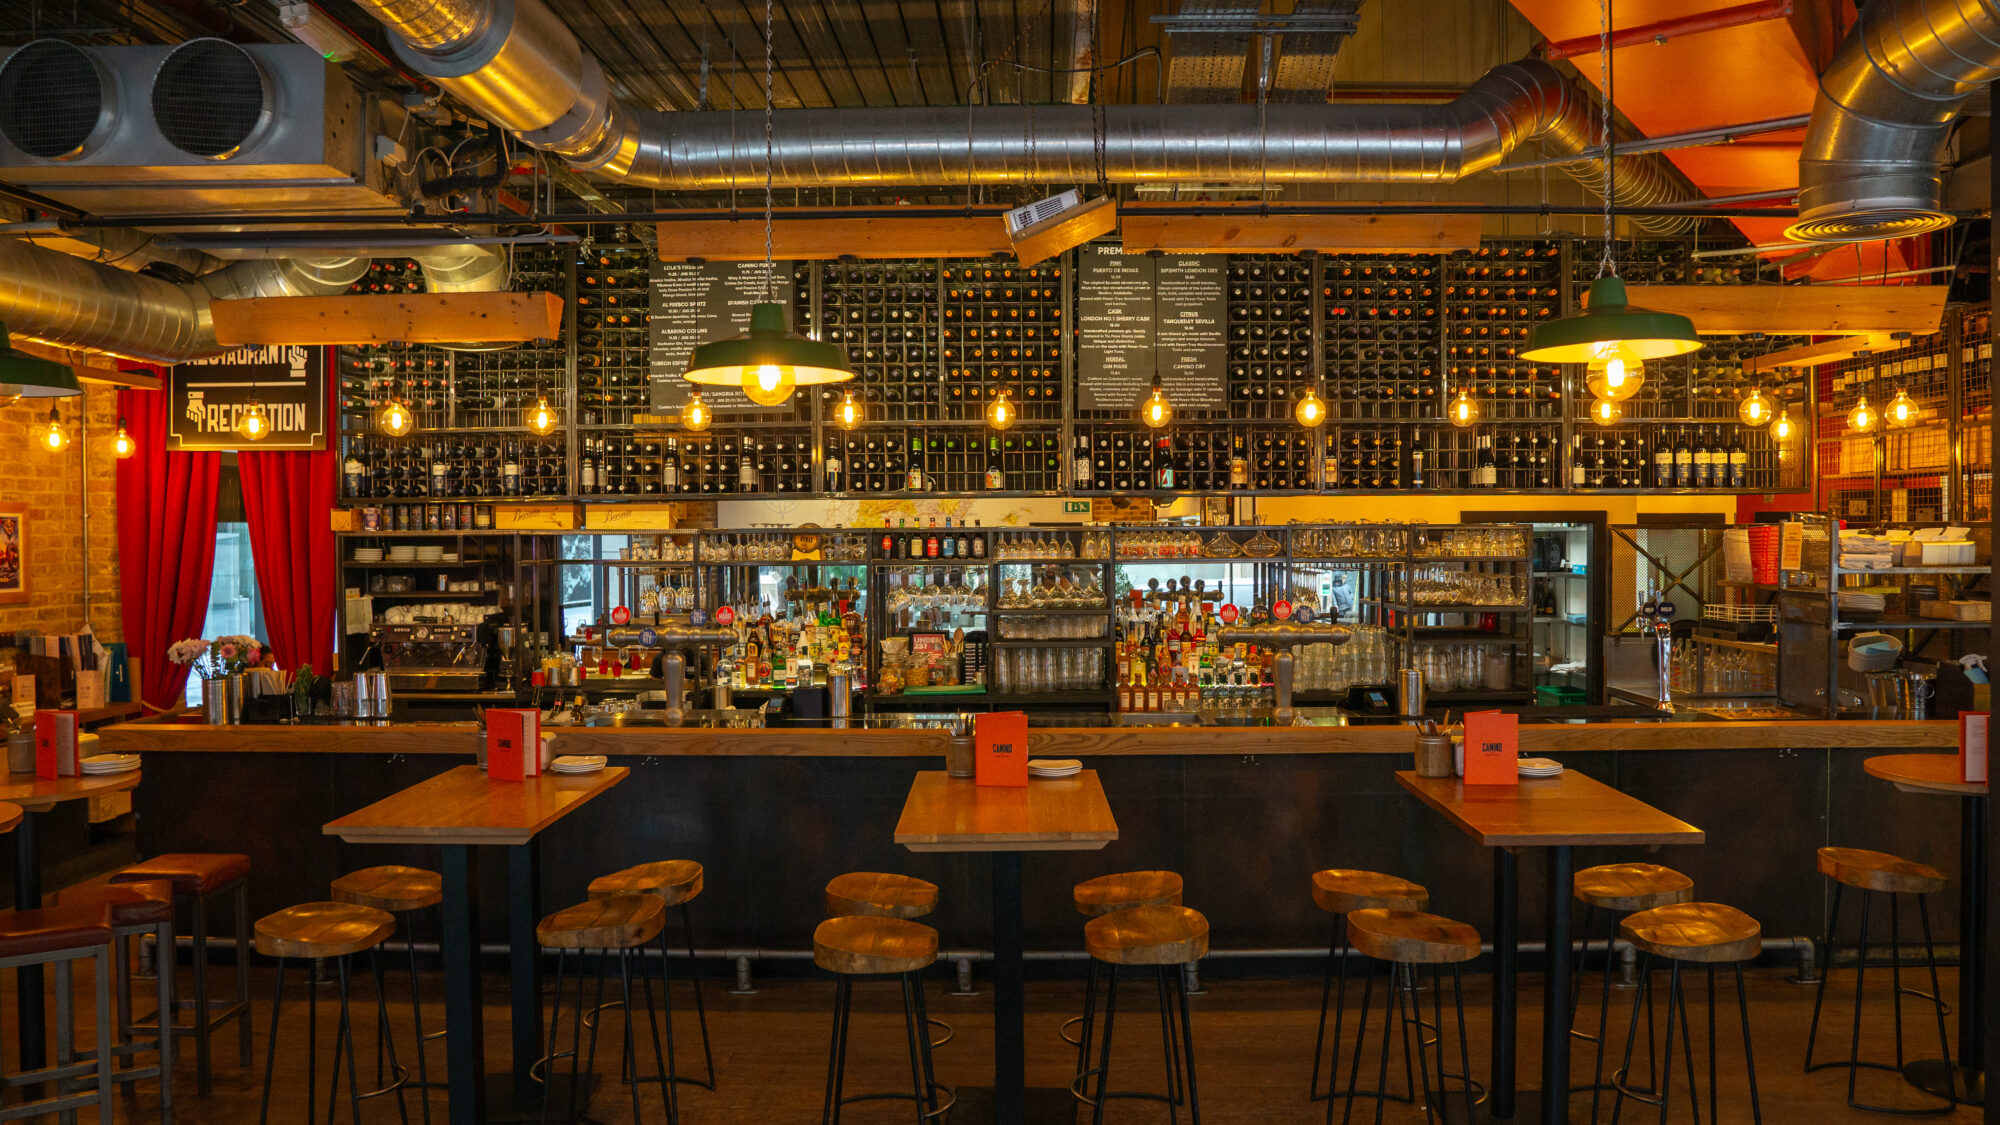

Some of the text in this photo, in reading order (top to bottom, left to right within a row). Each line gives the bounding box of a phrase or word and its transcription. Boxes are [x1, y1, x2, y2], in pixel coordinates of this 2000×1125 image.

[187, 344, 286, 366] AURANT
[207, 403, 305, 432] RECTION
[993, 744, 1012, 753] CAMINO
[1482, 742, 1502, 752] CAMINO
